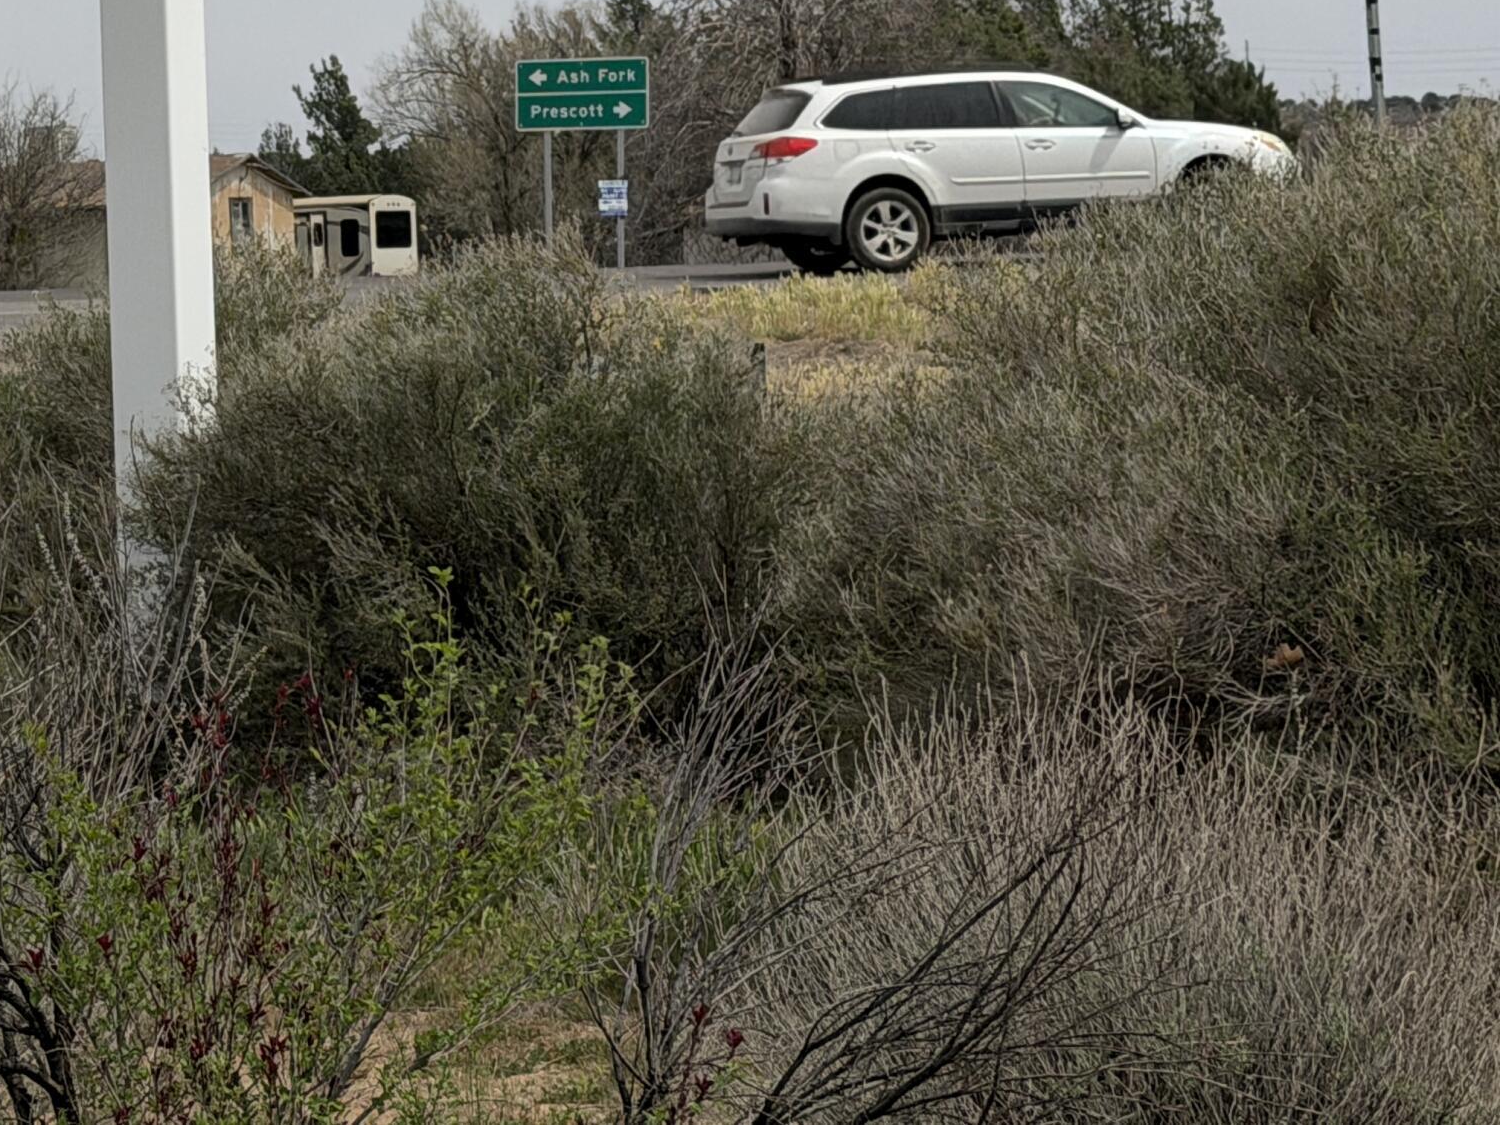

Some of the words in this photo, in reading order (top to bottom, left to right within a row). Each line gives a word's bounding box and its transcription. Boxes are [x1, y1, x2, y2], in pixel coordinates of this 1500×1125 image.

[557, 70, 590, 84] Ash
[598, 69, 636, 83] Fork
[530, 104, 604, 118] Prescott
